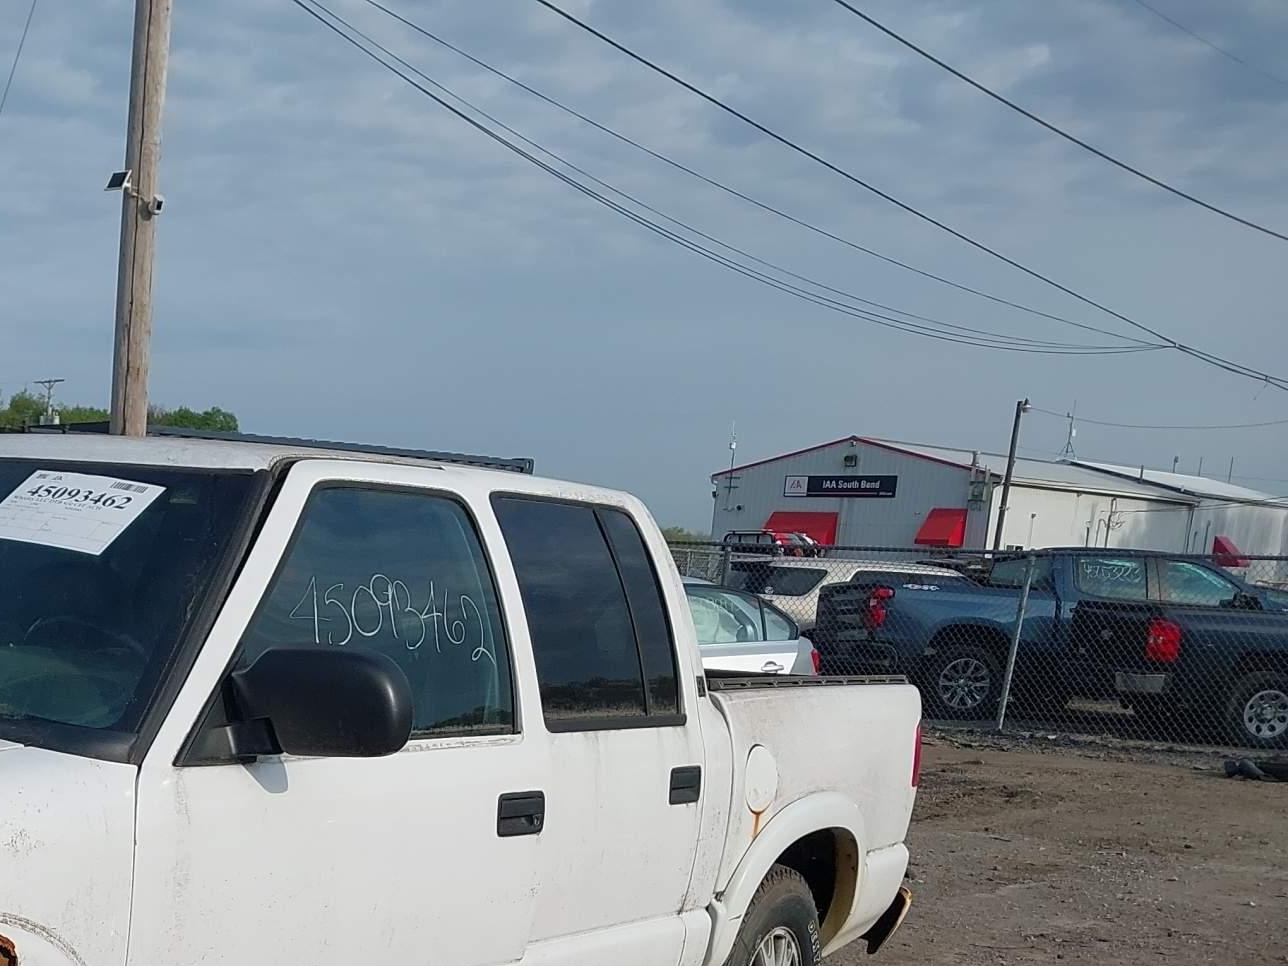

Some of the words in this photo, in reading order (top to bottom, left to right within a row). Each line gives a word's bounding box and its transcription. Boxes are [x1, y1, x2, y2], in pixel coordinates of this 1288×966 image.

[27, 484, 133, 510] 45093462
[822, 480, 836, 489] IAA
[838, 480, 859, 489] South
[861, 480, 880, 489] Bend
[289, 574, 496, 666] 45093462
